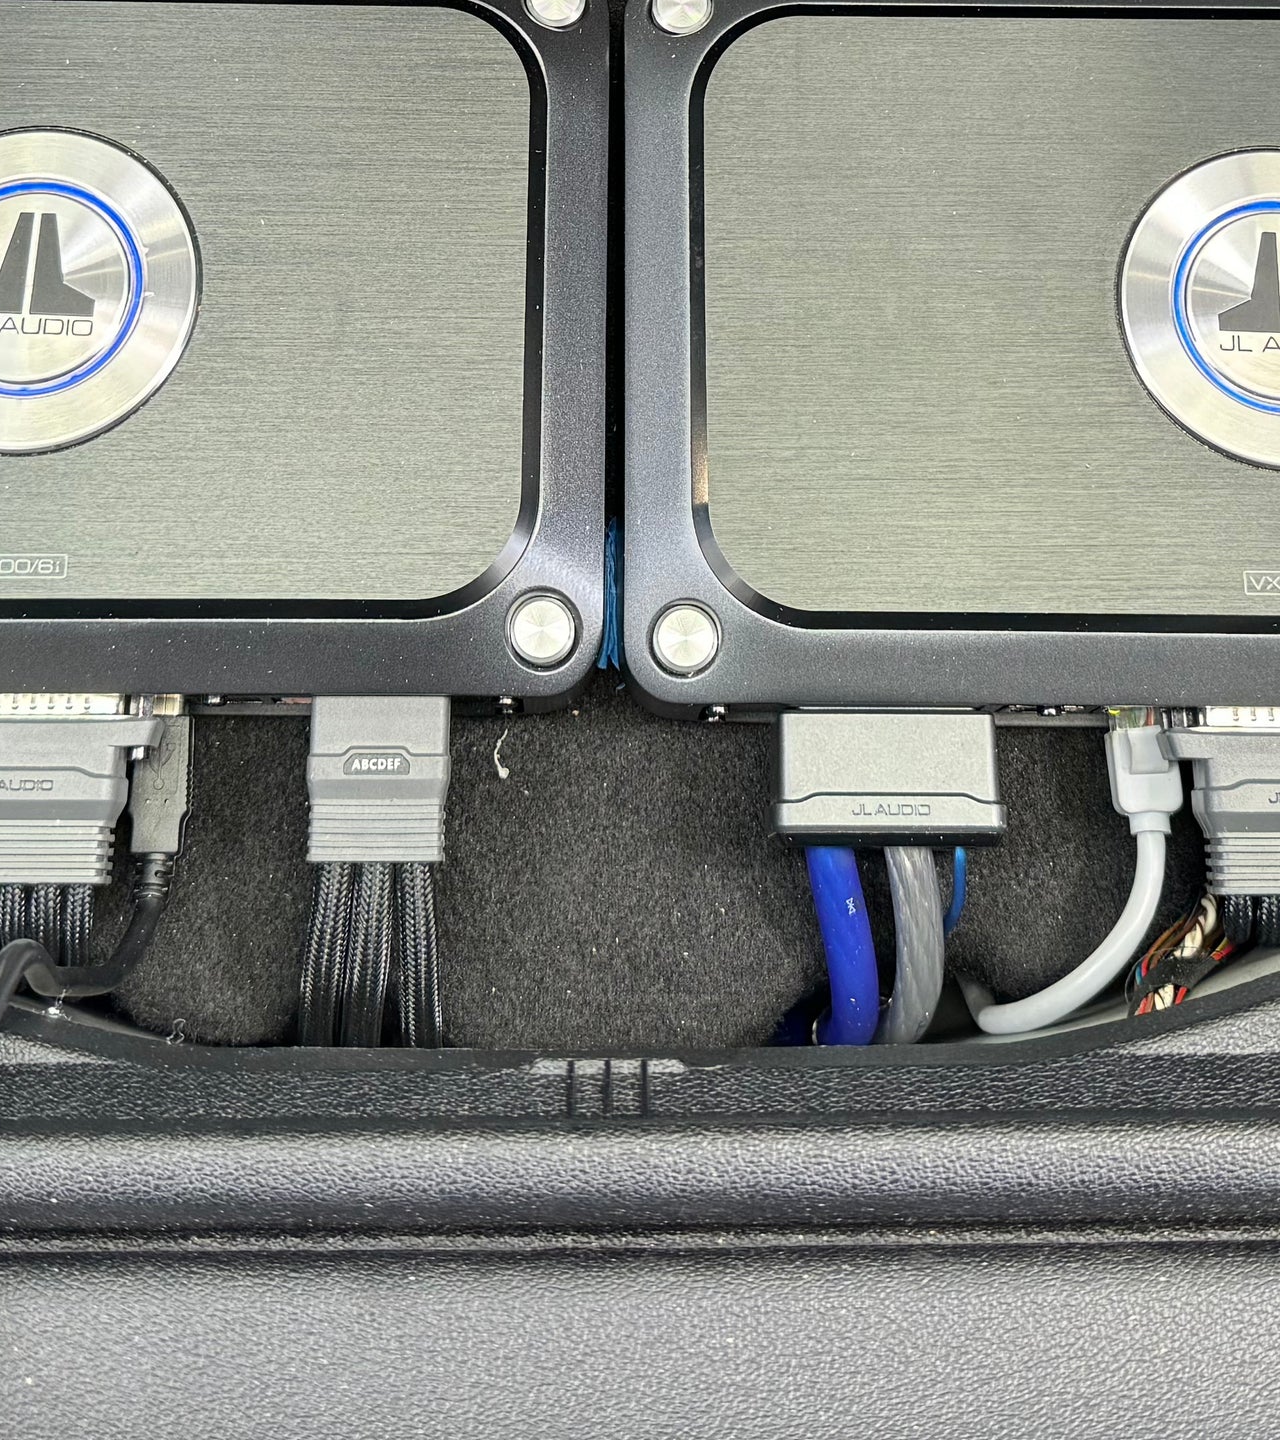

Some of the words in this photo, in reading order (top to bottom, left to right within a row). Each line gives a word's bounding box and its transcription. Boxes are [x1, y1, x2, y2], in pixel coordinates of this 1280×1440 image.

[1220, 335, 1252, 352] JL
[351, 757, 402, 772] ABCDEF
[851, 803, 872, 816] JL
[874, 803, 931, 816] AUDIO
